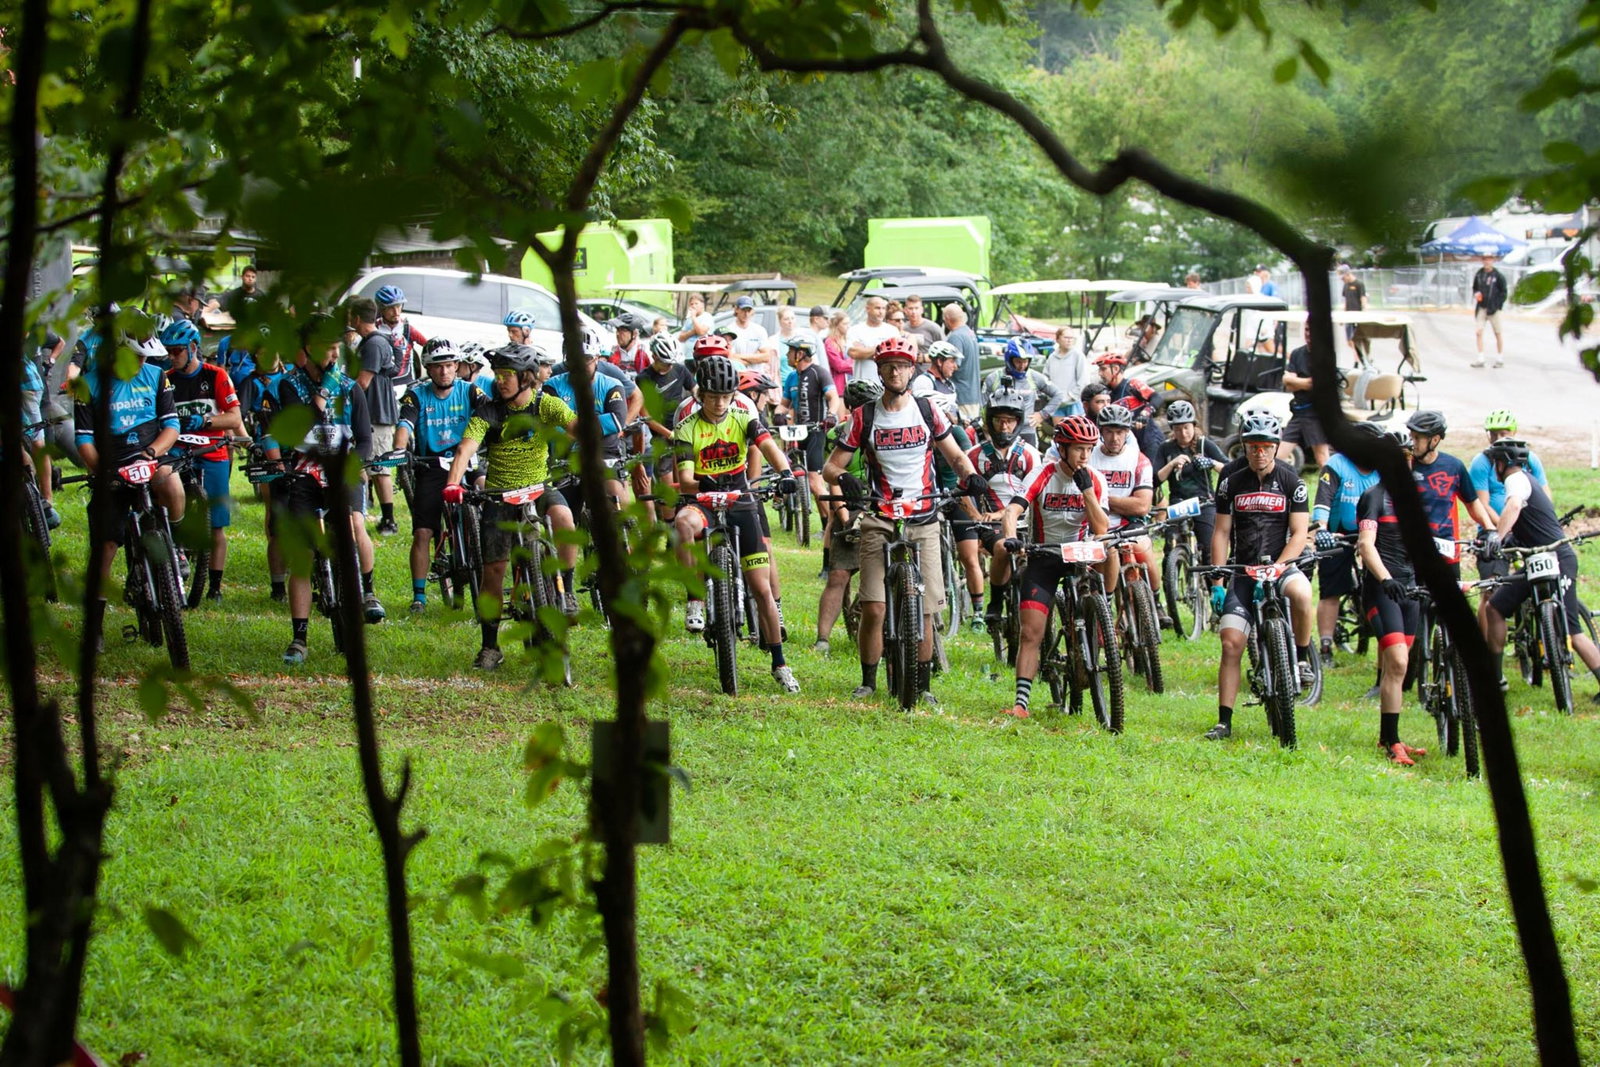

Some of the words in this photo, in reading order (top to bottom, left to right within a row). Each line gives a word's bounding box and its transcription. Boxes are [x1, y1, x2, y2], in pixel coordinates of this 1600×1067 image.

[111, 399, 144, 411] mpakt
[875, 426, 926, 446] GEAR
[701, 456, 741, 470] XTREME
[128, 467, 151, 481] 50
[1102, 470, 1130, 484] EAR
[520, 495, 529, 504] 2
[1237, 495, 1283, 506] HAMMER
[893, 504, 904, 517] 5
[1073, 547, 1093, 560] 53
[745, 557, 769, 567] XTREM
[1529, 558, 1553, 574] 150
[1256, 568, 1277, 581] 52
